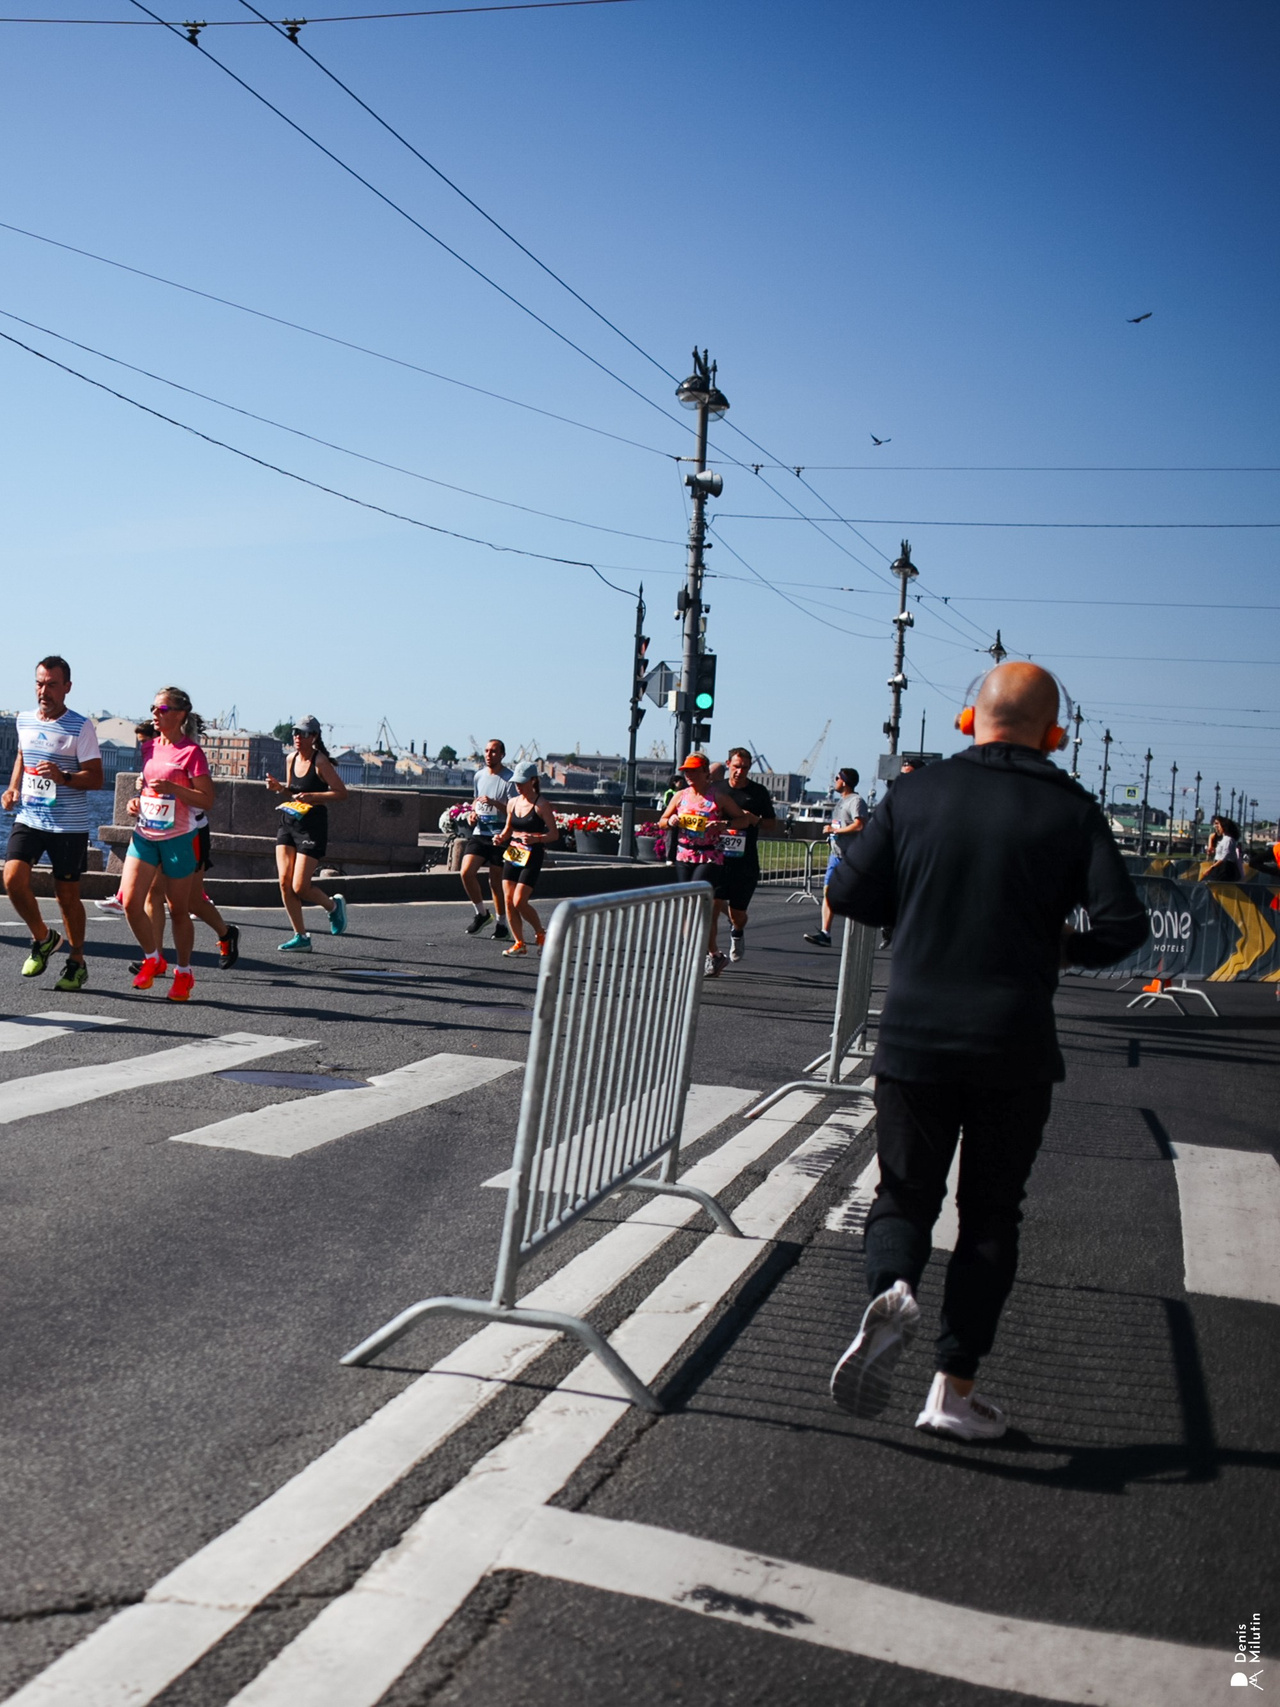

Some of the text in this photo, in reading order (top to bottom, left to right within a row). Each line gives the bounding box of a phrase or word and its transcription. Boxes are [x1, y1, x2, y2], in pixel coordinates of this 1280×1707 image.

[28, 777, 51, 791] 3149
[144, 802, 170, 816] 7297
[1153, 944, 1185, 953] HOTELS
